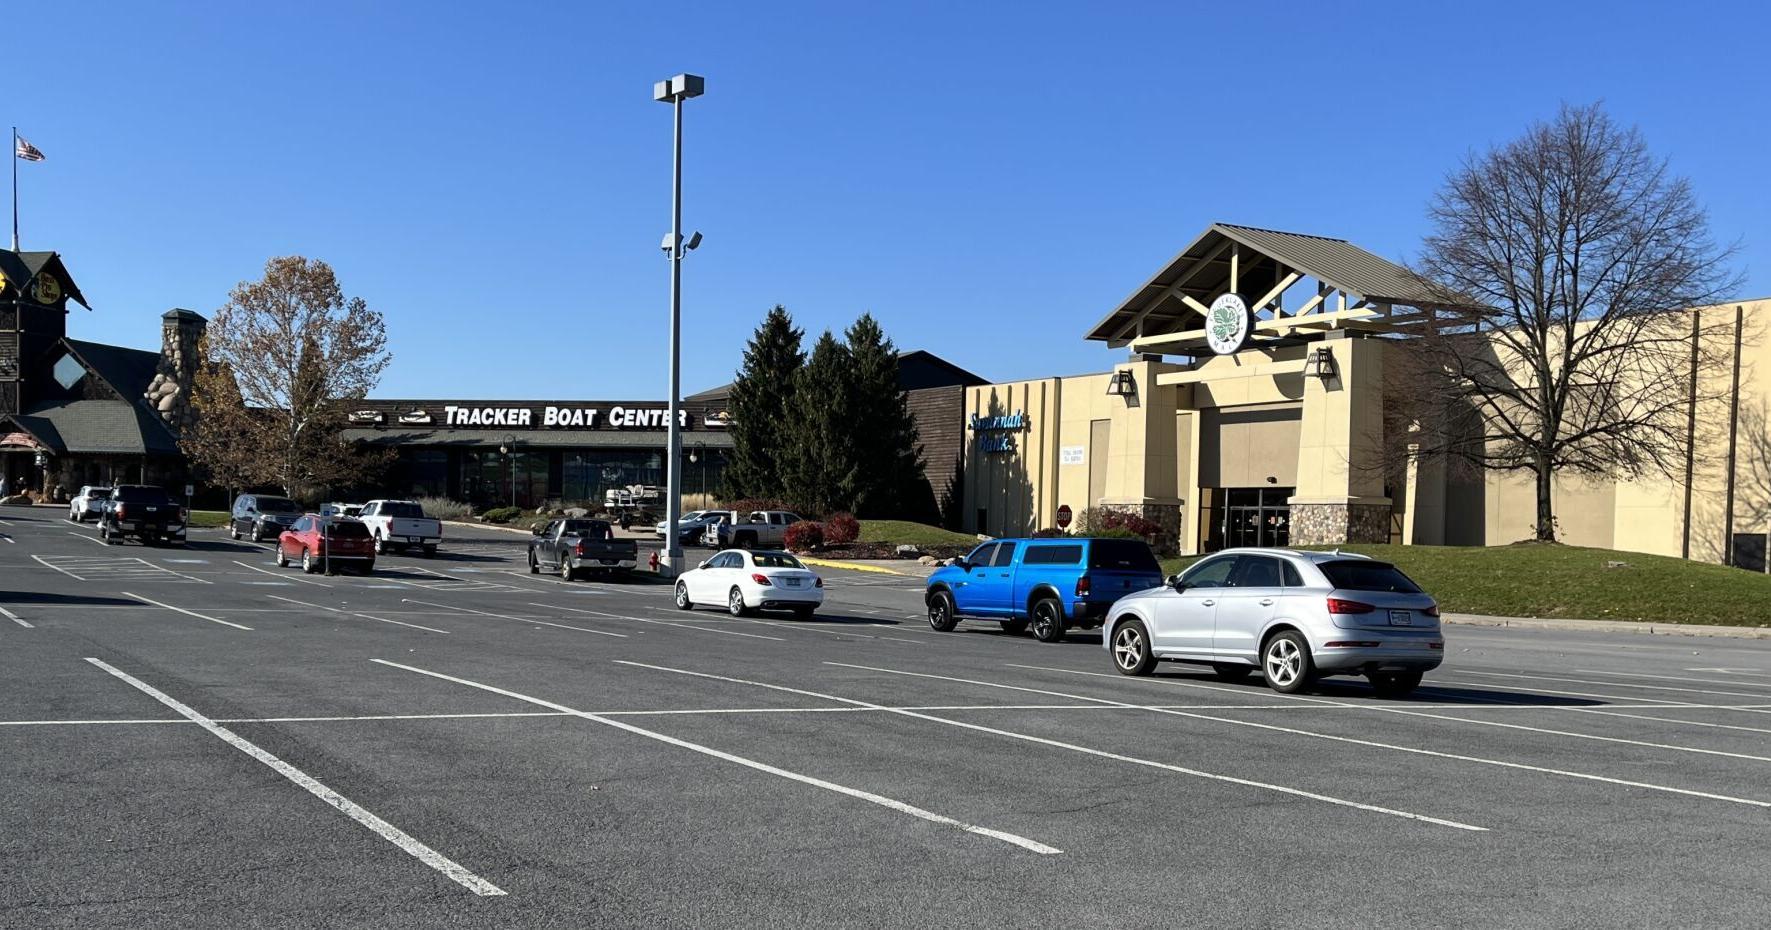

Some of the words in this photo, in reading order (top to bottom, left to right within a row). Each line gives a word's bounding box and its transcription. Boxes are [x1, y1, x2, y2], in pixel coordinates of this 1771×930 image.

[444, 405, 532, 425] TRACKER
[544, 406, 597, 426] BOAT
[1057, 511, 1072, 521] STOP
